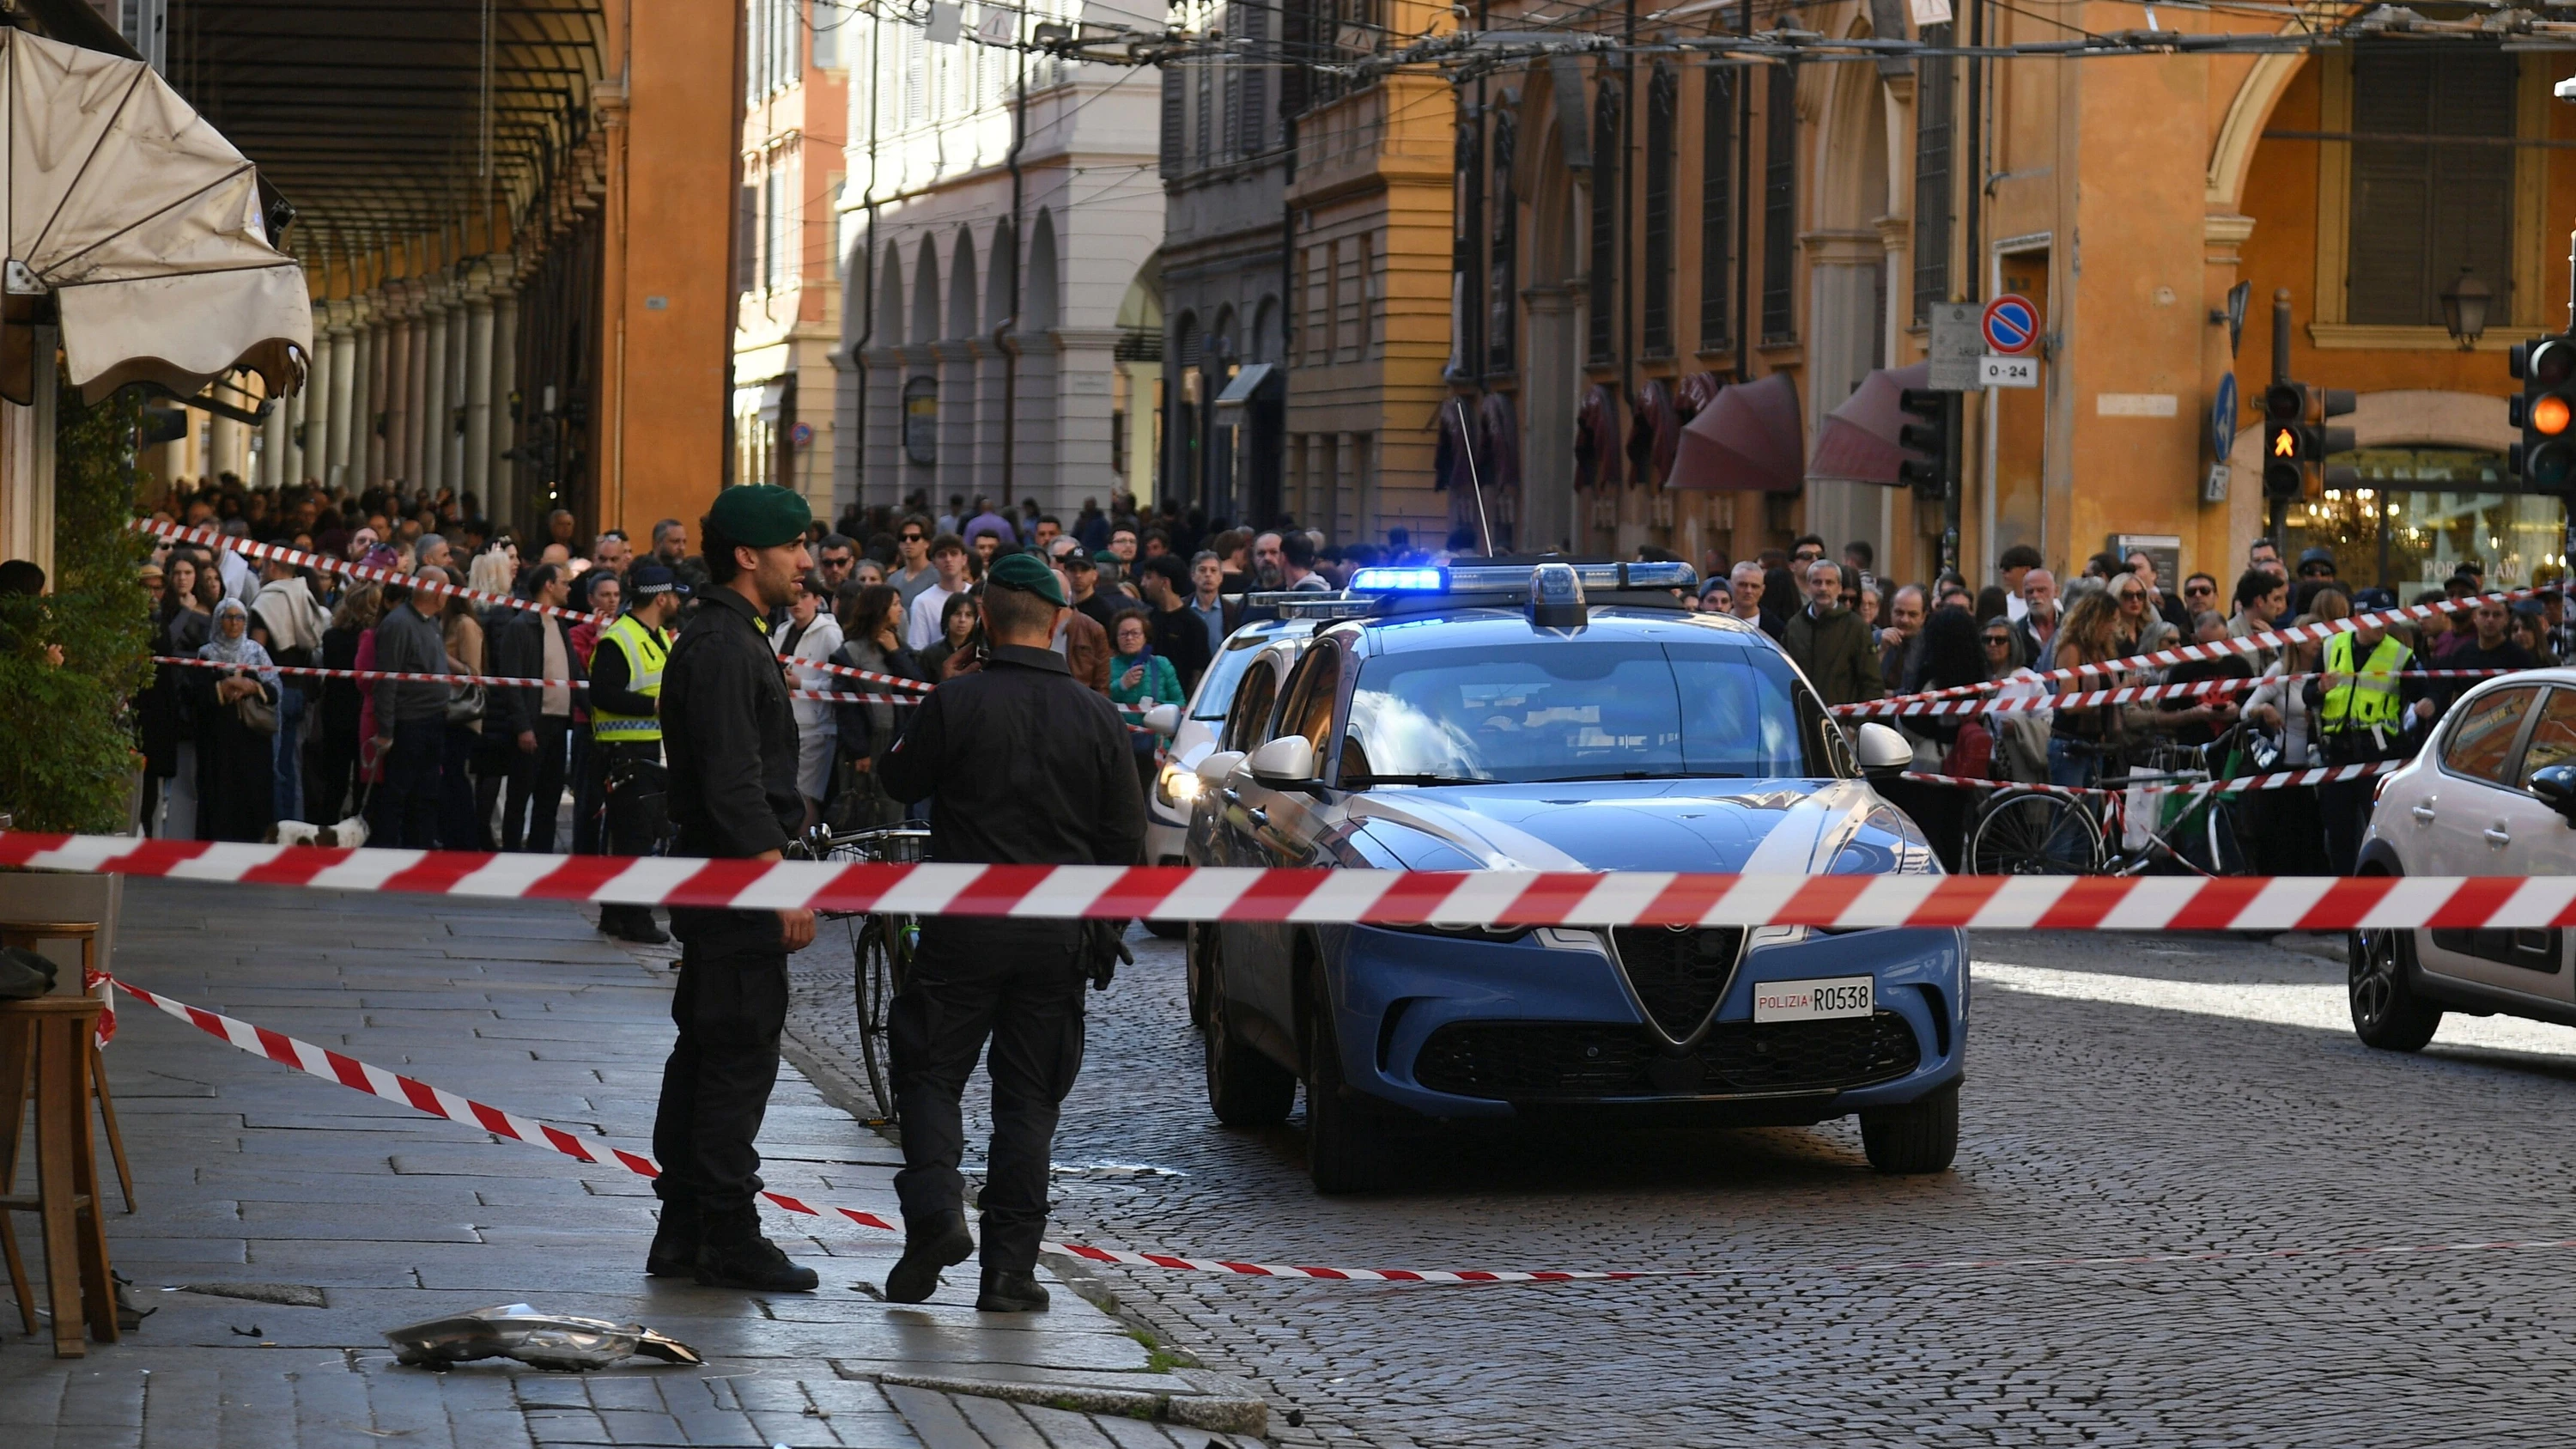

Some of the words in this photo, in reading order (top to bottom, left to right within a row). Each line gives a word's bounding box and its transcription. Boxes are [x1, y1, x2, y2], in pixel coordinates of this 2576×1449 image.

[2423, 560, 2527, 580] PORLANA
[1759, 995, 1808, 1009] POLIZIA
[1814, 986, 1868, 1011] R0538
